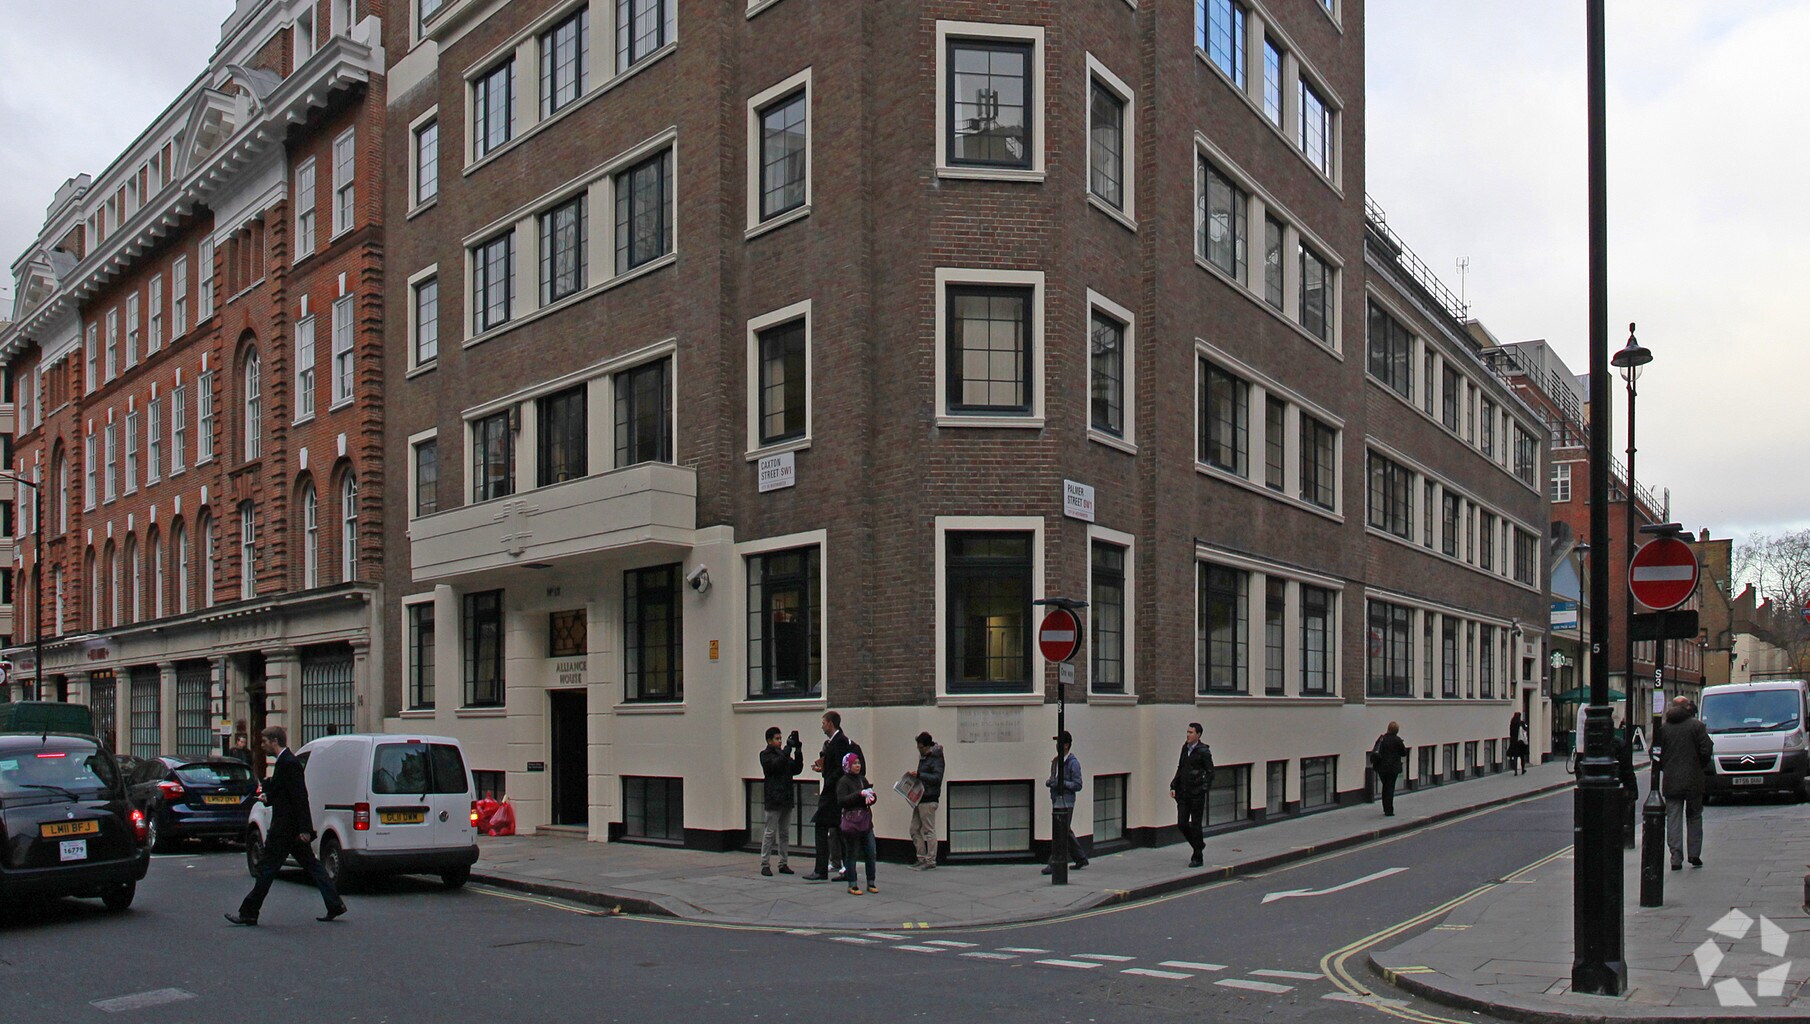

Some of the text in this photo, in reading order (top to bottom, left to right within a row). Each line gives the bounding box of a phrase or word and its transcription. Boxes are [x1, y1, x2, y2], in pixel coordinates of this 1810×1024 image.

[761, 458, 781, 470] CAXTON
[761, 466, 792, 480] STREET SW1
[1067, 484, 1084, 496] PALMER
[1067, 495, 1093, 510] STREET SW1
[1593, 643, 1600, 653] 5
[556, 661, 587, 673] ALLIANCE
[560, 673, 582, 684] HOUSE
[50, 822, 91, 835] LM11 BFJ
[63, 846, 84, 854] 16779
